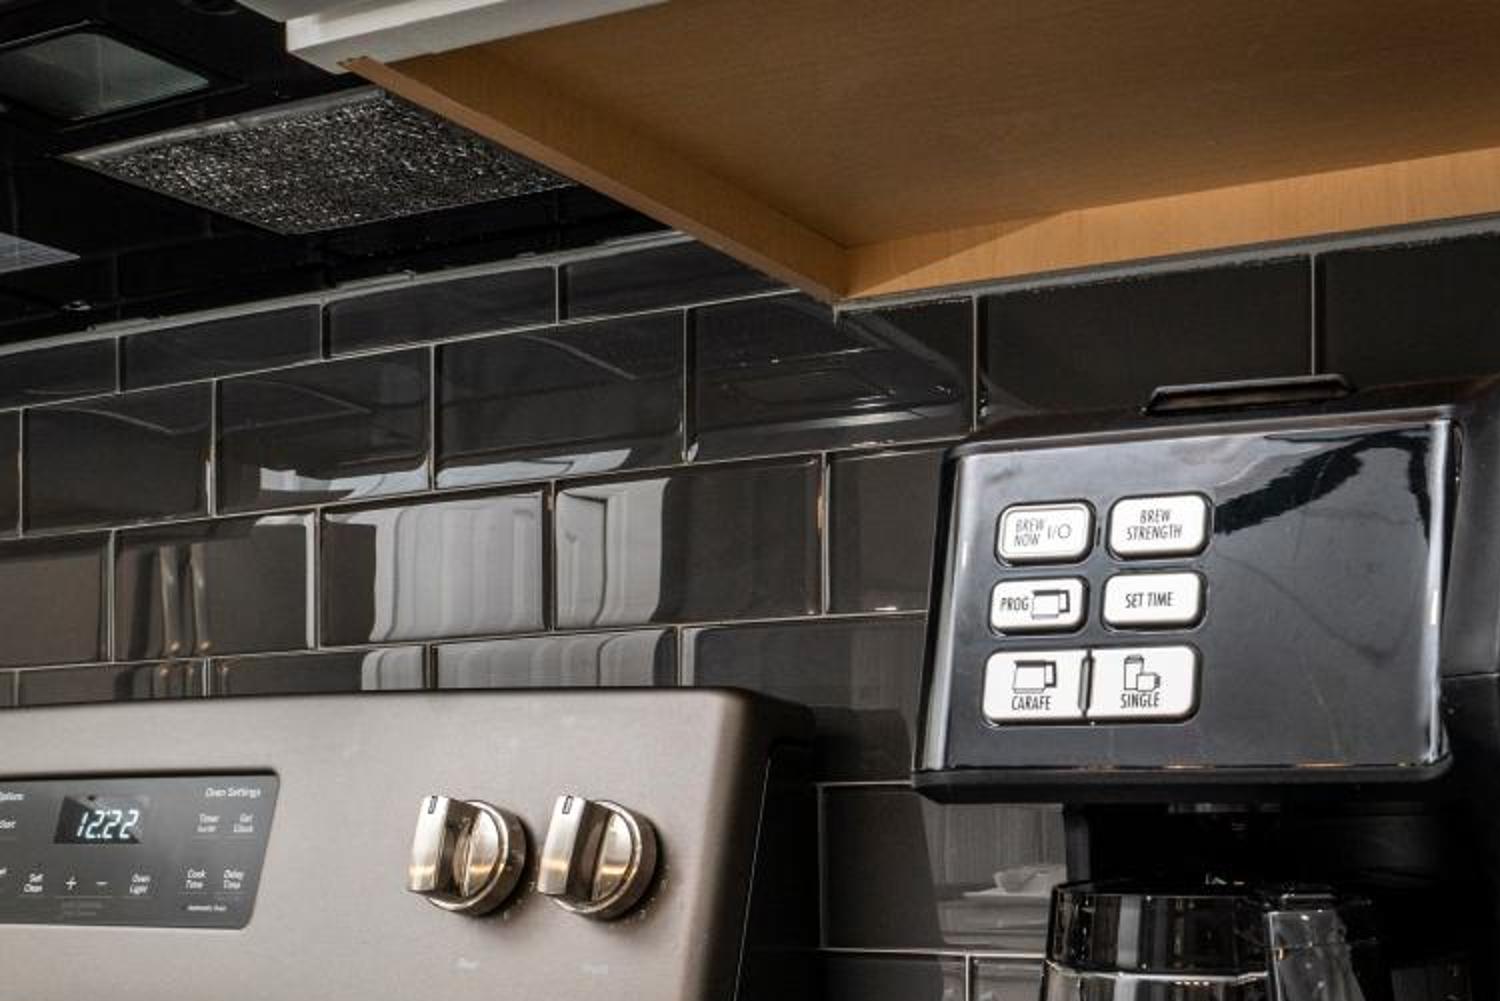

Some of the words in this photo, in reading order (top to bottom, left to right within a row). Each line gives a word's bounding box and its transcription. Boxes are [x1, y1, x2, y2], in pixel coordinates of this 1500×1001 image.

[1139, 509, 1171, 524] BREW
[1015, 517, 1045, 533] BREW
[1126, 524, 1183, 541] STRENGTH
[1014, 533, 1041, 547] NOW
[1001, 596, 1029, 612] PROG
[1125, 592, 1143, 609] SET
[1147, 591, 1174, 608] TIME
[1011, 694, 1052, 711] CARAFE
[1120, 690, 1161, 709] SINGLE
[187, 869, 206, 879] Cook
